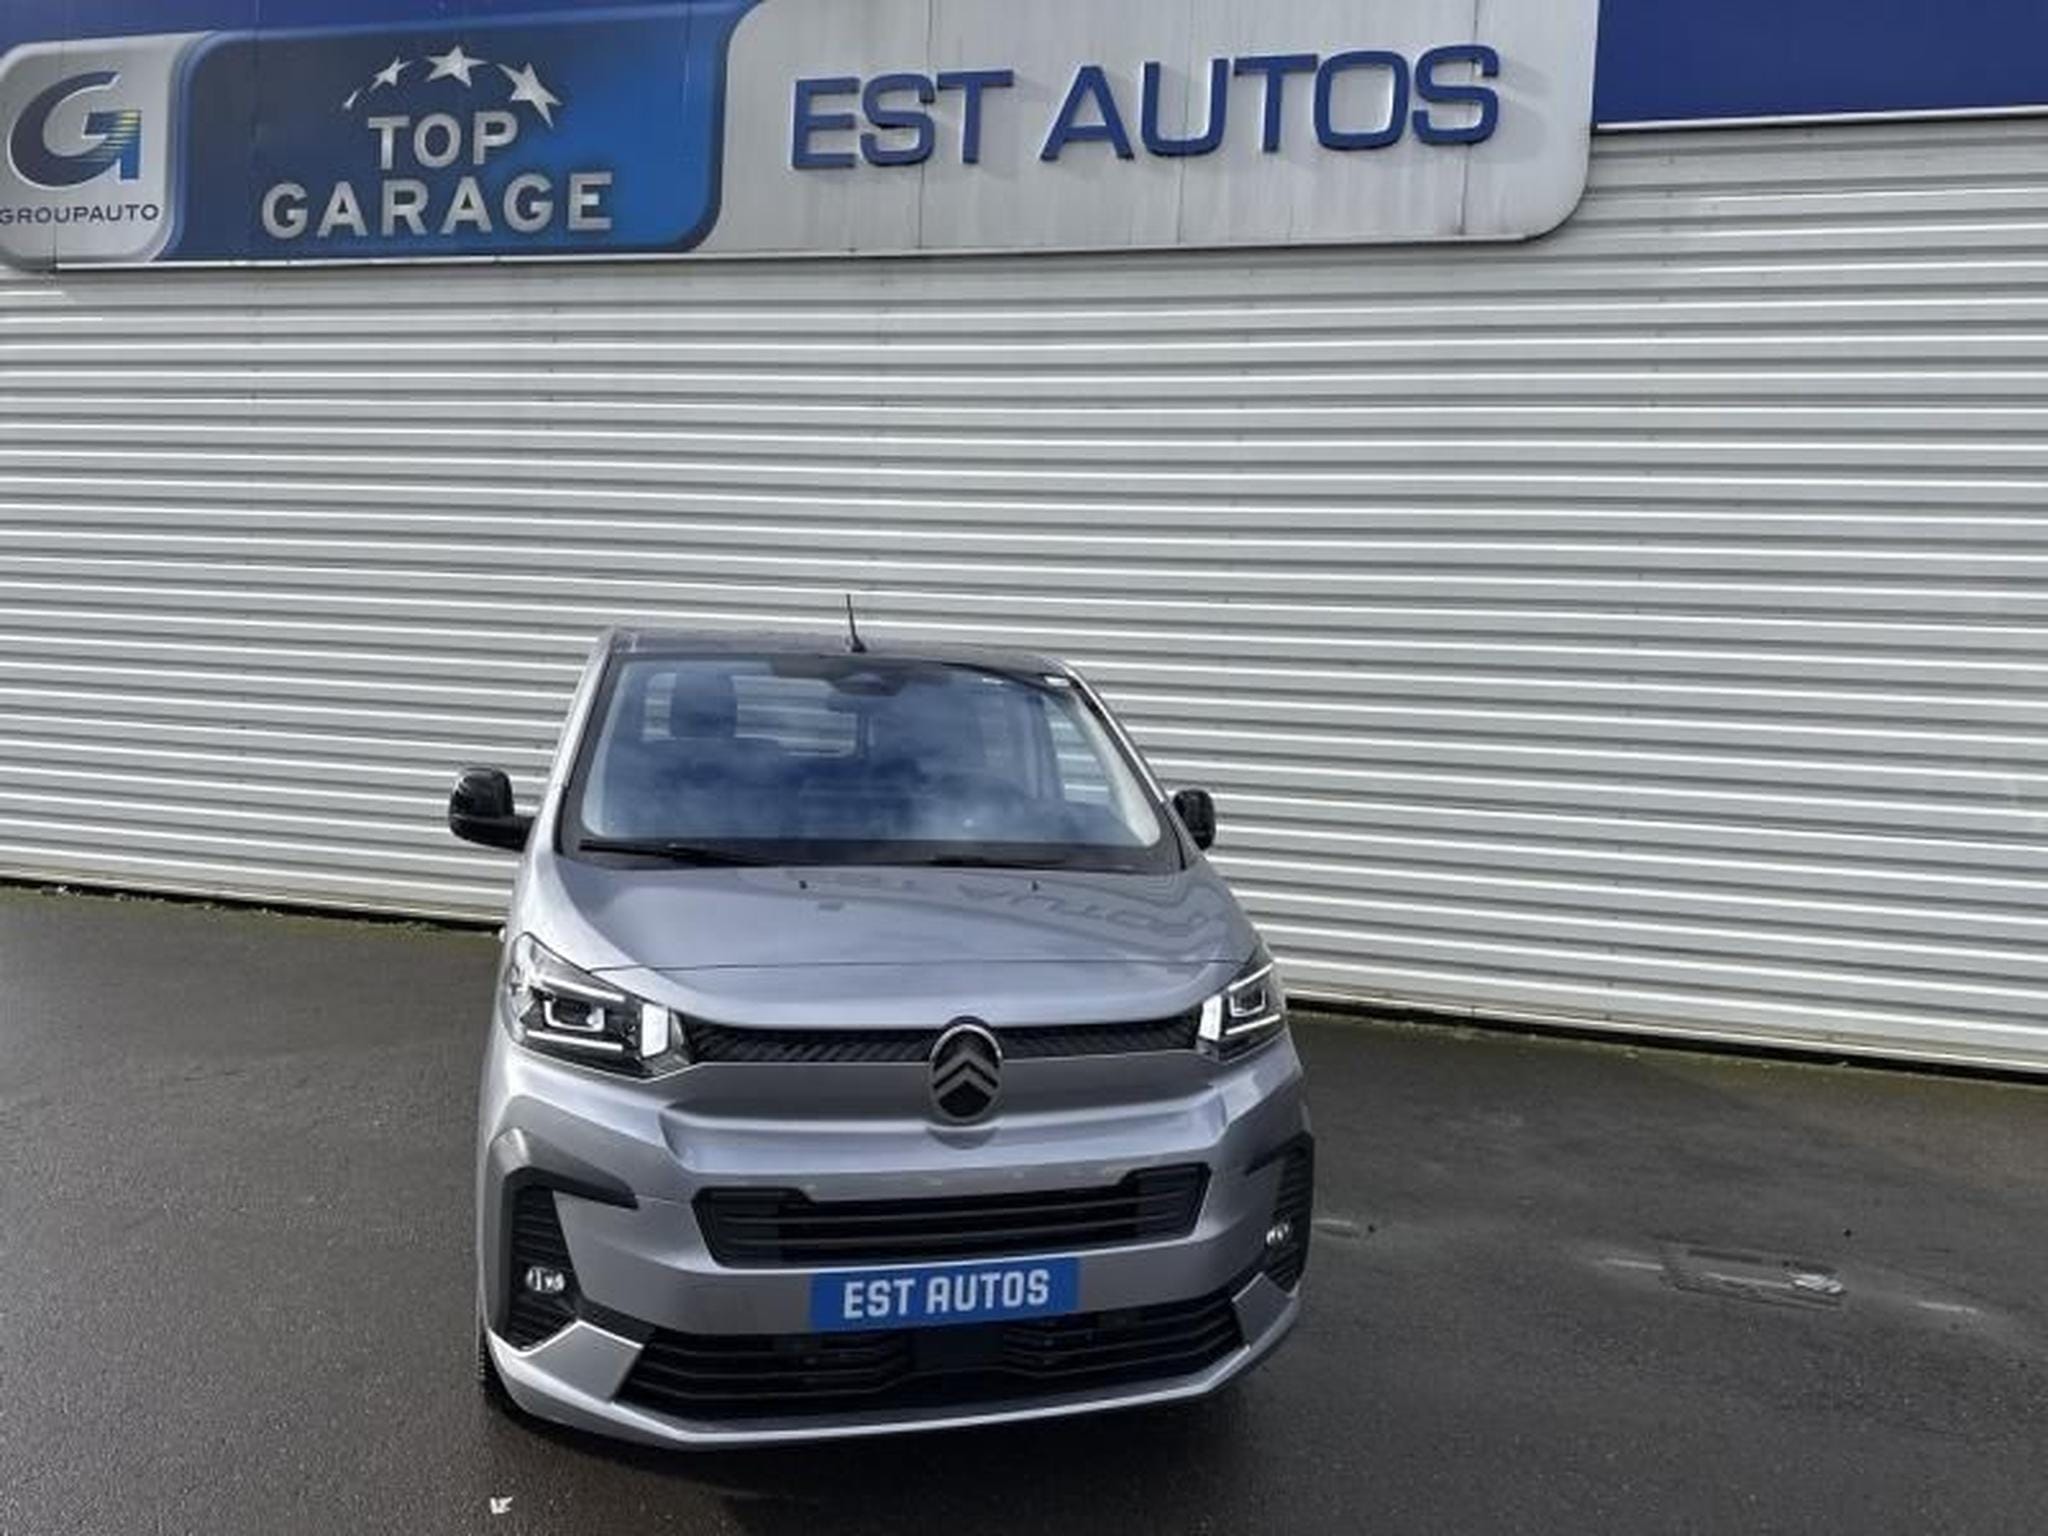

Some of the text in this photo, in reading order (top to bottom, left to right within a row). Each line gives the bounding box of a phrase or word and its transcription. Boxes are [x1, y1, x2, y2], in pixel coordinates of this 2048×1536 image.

[793, 45, 1499, 170] EST AUTOS
[368, 111, 520, 170] TOP
[0, 203, 160, 225] GROUPAUTO
[262, 172, 613, 240] GARAGE
[843, 1269, 1051, 1319] EST AUTOS
